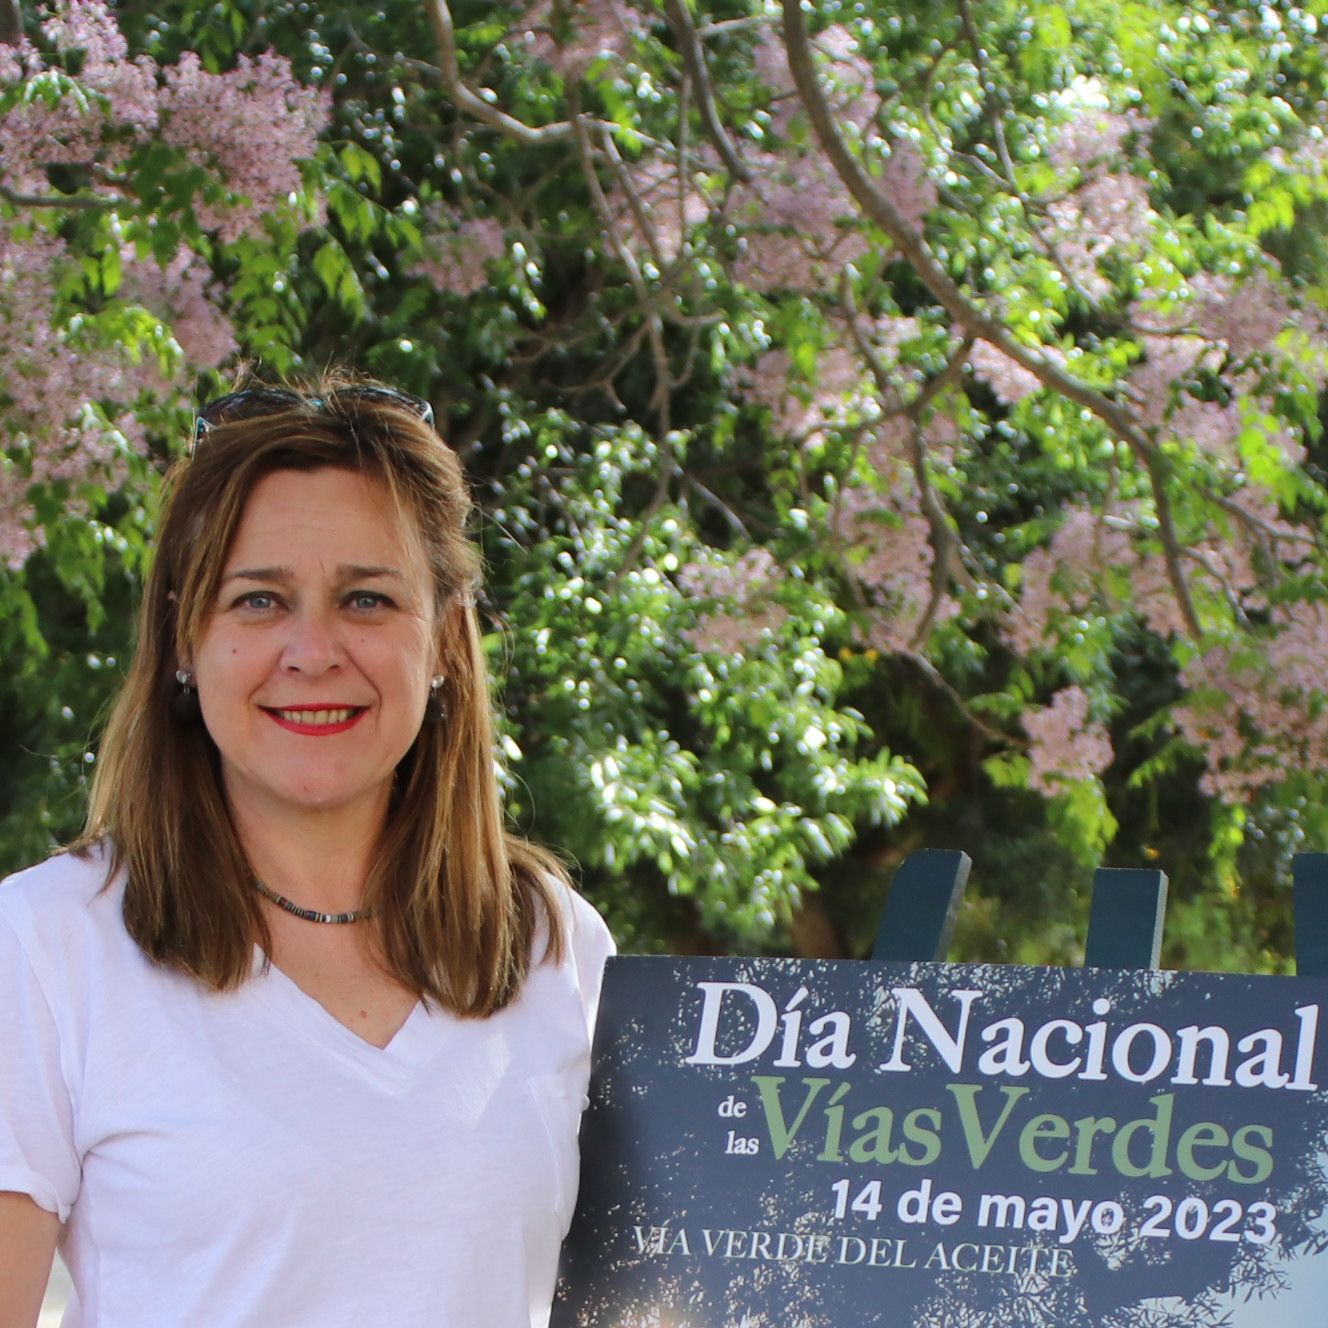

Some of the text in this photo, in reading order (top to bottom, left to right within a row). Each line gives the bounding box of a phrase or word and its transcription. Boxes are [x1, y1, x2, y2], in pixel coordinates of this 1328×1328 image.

[685, 981, 1320, 1091] Día Nacional
[717, 1095, 747, 1119] de
[751, 1076, 1274, 1185] Vías Verdes
[725, 1130, 760, 1155] las
[831, 1178, 1277, 1244] 14 de mayo 2023
[700, 1228, 829, 1264] VERDE
[836, 1236, 918, 1269] DEL
[924, 1242, 1076, 1278] ACEITE
